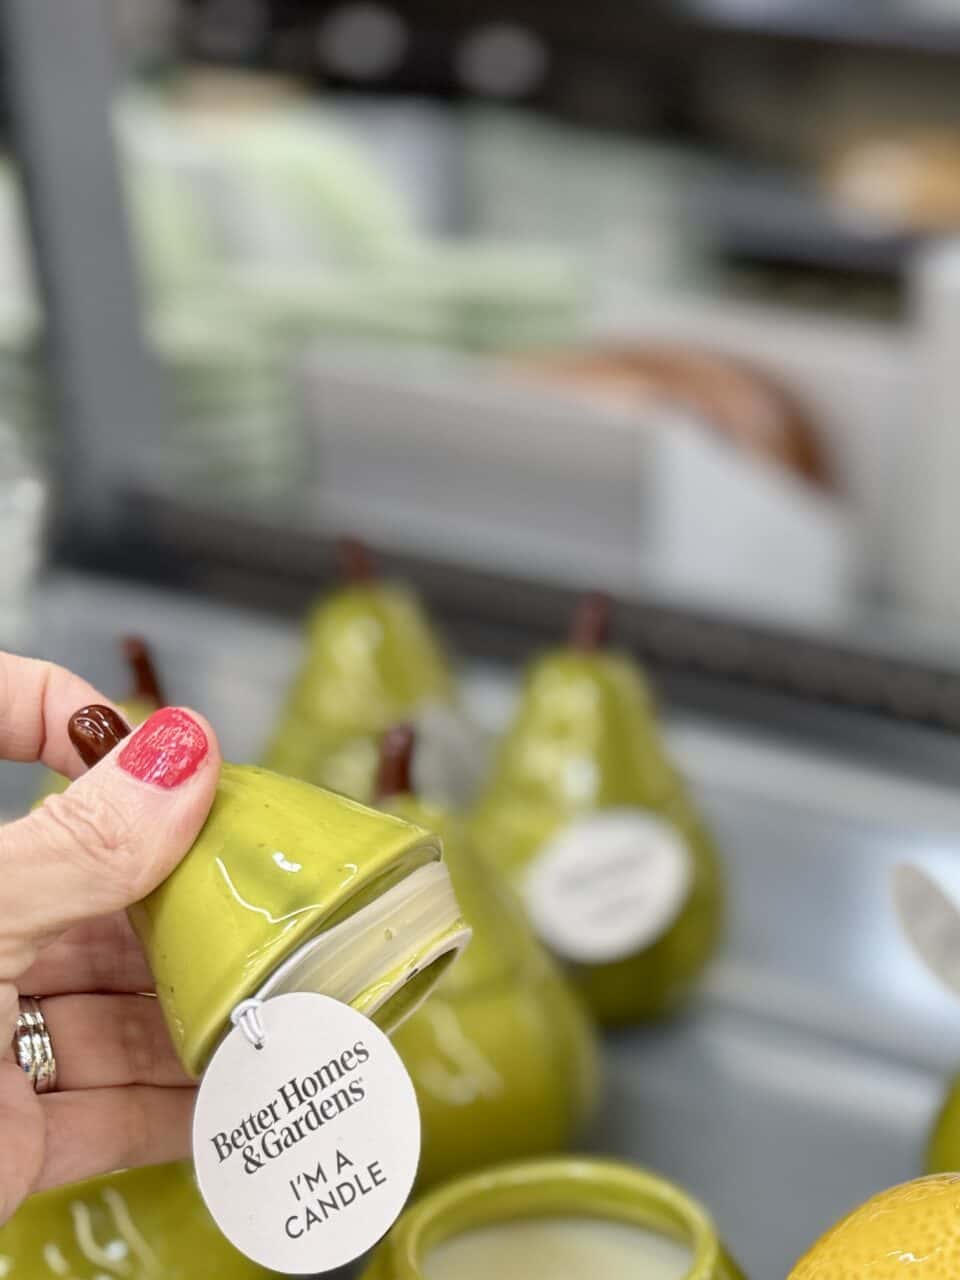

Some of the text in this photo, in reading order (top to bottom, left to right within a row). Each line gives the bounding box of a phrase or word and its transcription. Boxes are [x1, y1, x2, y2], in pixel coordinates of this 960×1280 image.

[210, 1041, 370, 1163] Better Homes
[284, 1161, 387, 1239] CANDLE
[289, 1149, 354, 1201] I'M A
